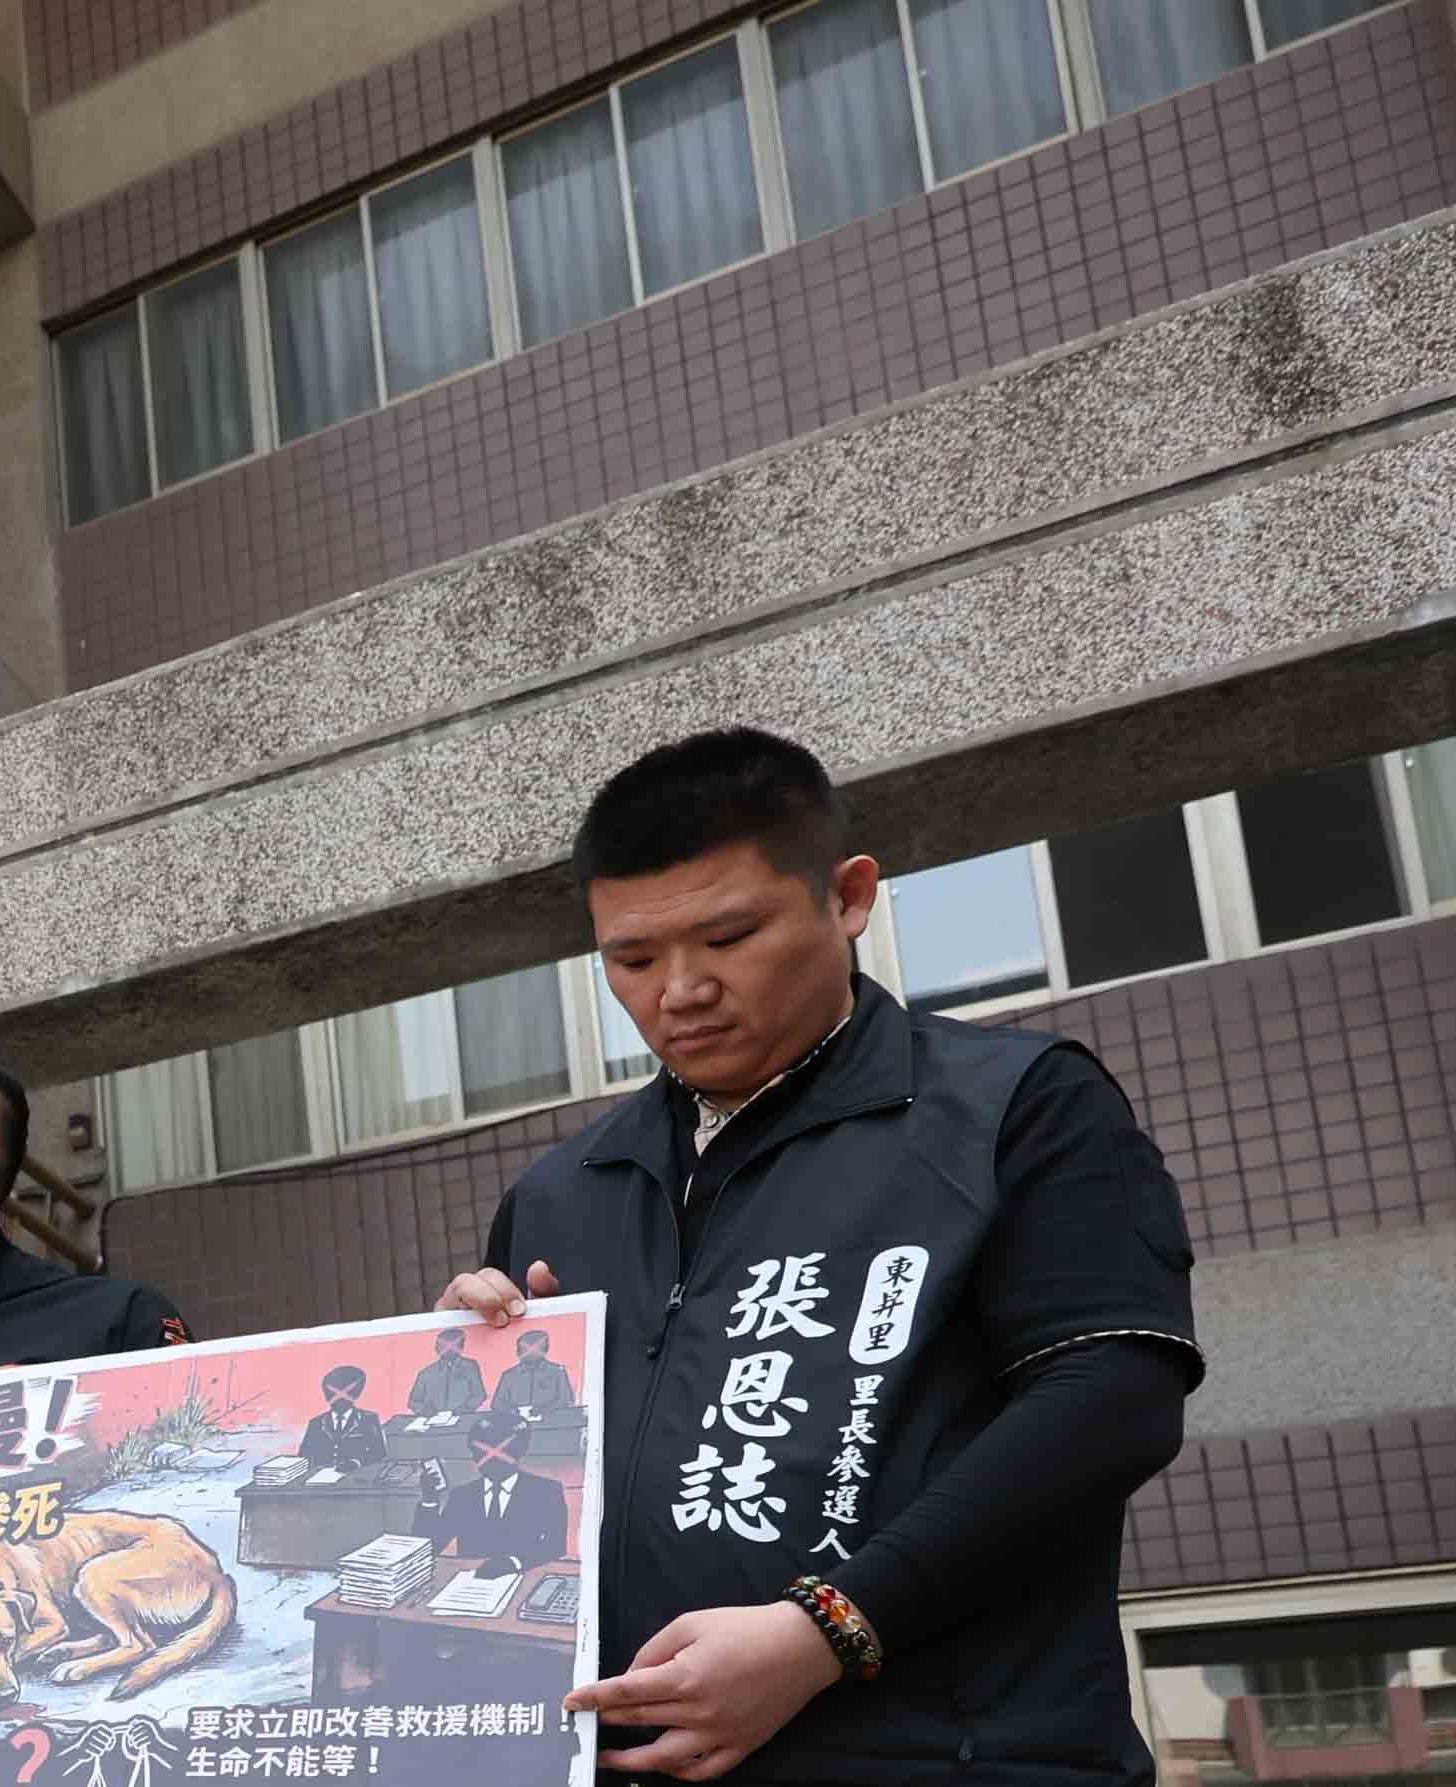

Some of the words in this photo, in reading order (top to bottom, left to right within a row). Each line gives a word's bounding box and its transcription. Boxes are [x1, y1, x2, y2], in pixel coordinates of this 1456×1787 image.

[672, 1252, 837, 1543] 張恩誌
[809, 1375, 885, 1560] 里長參選人
[186, 1745, 379, 1777] 生命不能等！
[190, 1703, 574, 1740] 要求立即改善救援機制！
